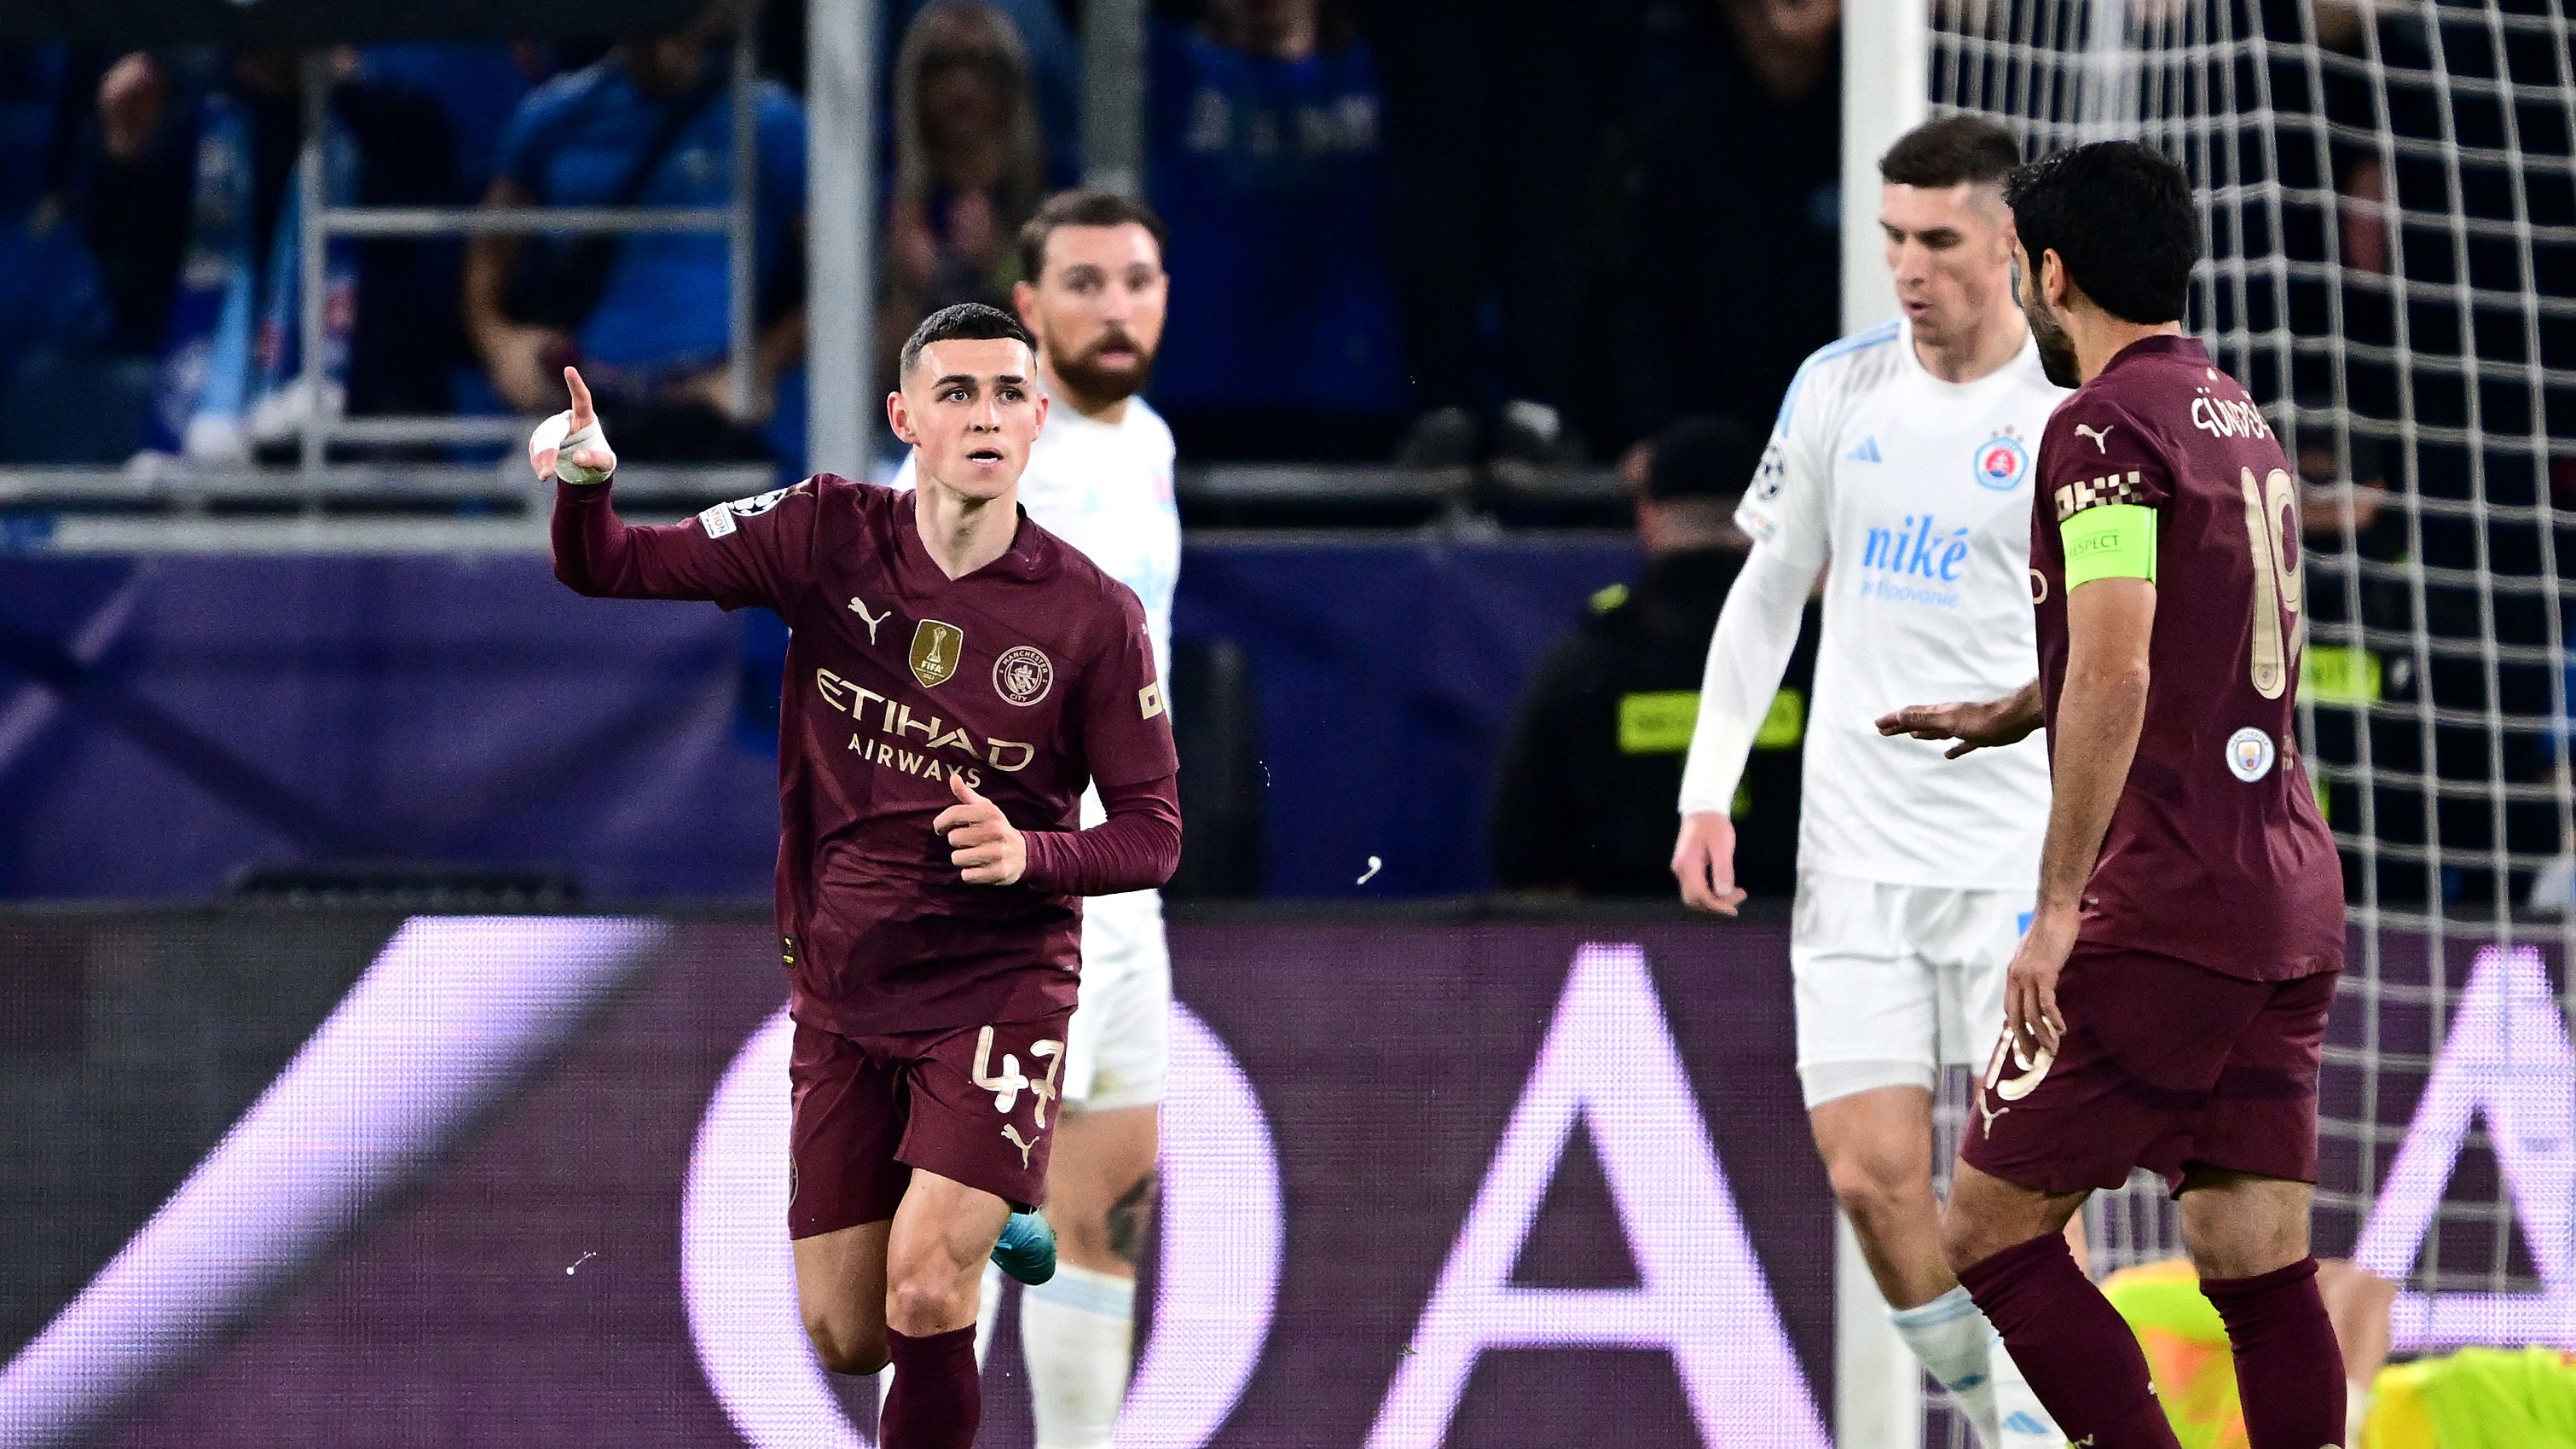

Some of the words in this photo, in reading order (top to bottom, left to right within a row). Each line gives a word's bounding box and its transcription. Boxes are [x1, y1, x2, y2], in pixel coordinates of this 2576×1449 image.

[1862, 514, 1969, 582] niké
[2241, 467, 2301, 699] 19
[921, 660, 941, 673] FIFA
[1002, 651, 1048, 674] MANCHESTER
[816, 668, 1034, 772] ETIHAD
[1010, 693, 1028, 702] CITY
[973, 1025, 1064, 1128] 47
